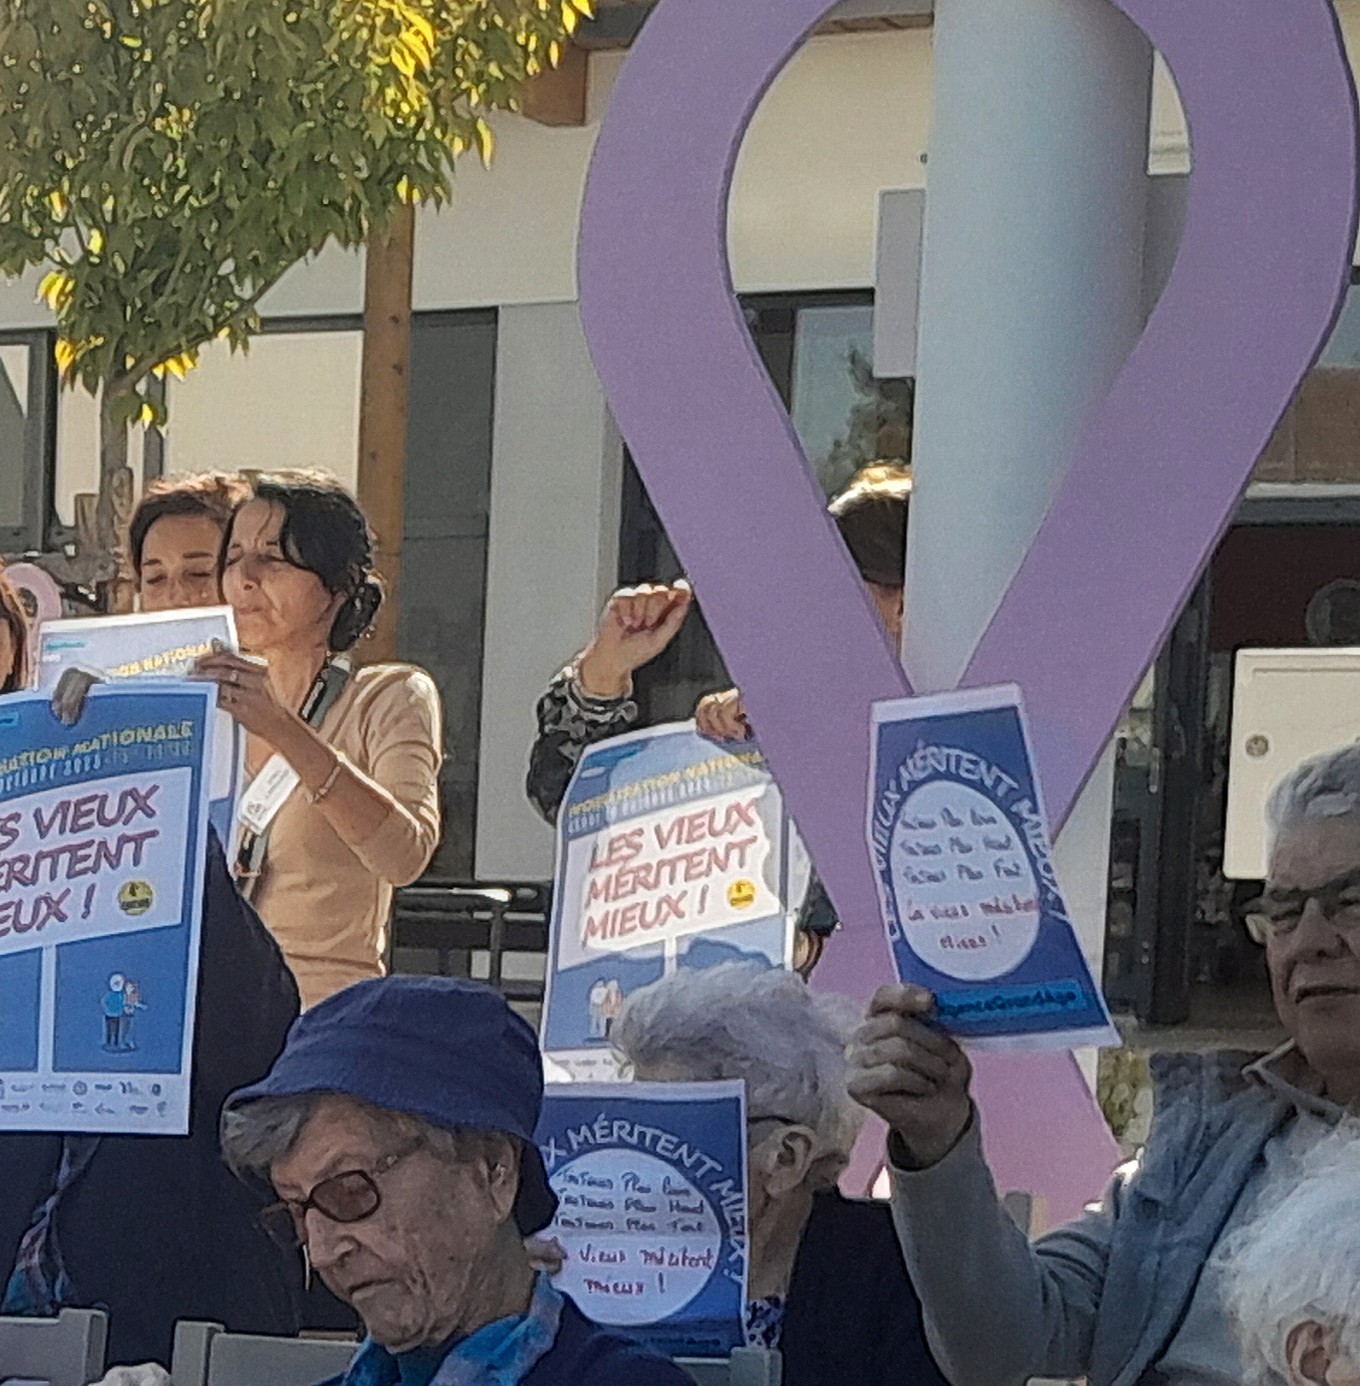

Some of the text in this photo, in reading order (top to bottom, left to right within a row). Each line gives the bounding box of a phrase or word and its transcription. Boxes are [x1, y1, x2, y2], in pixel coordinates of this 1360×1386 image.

[32, 784, 160, 840] VIEUX
[589, 827, 645, 873] LES
[654, 797, 757, 850] VIEUX
[81, 883, 96, 919] !
[584, 836, 758, 909] MÉRITENT
[581, 889, 688, 948] MIEUX
[566, 1112, 723, 1179] MÉRITENT
